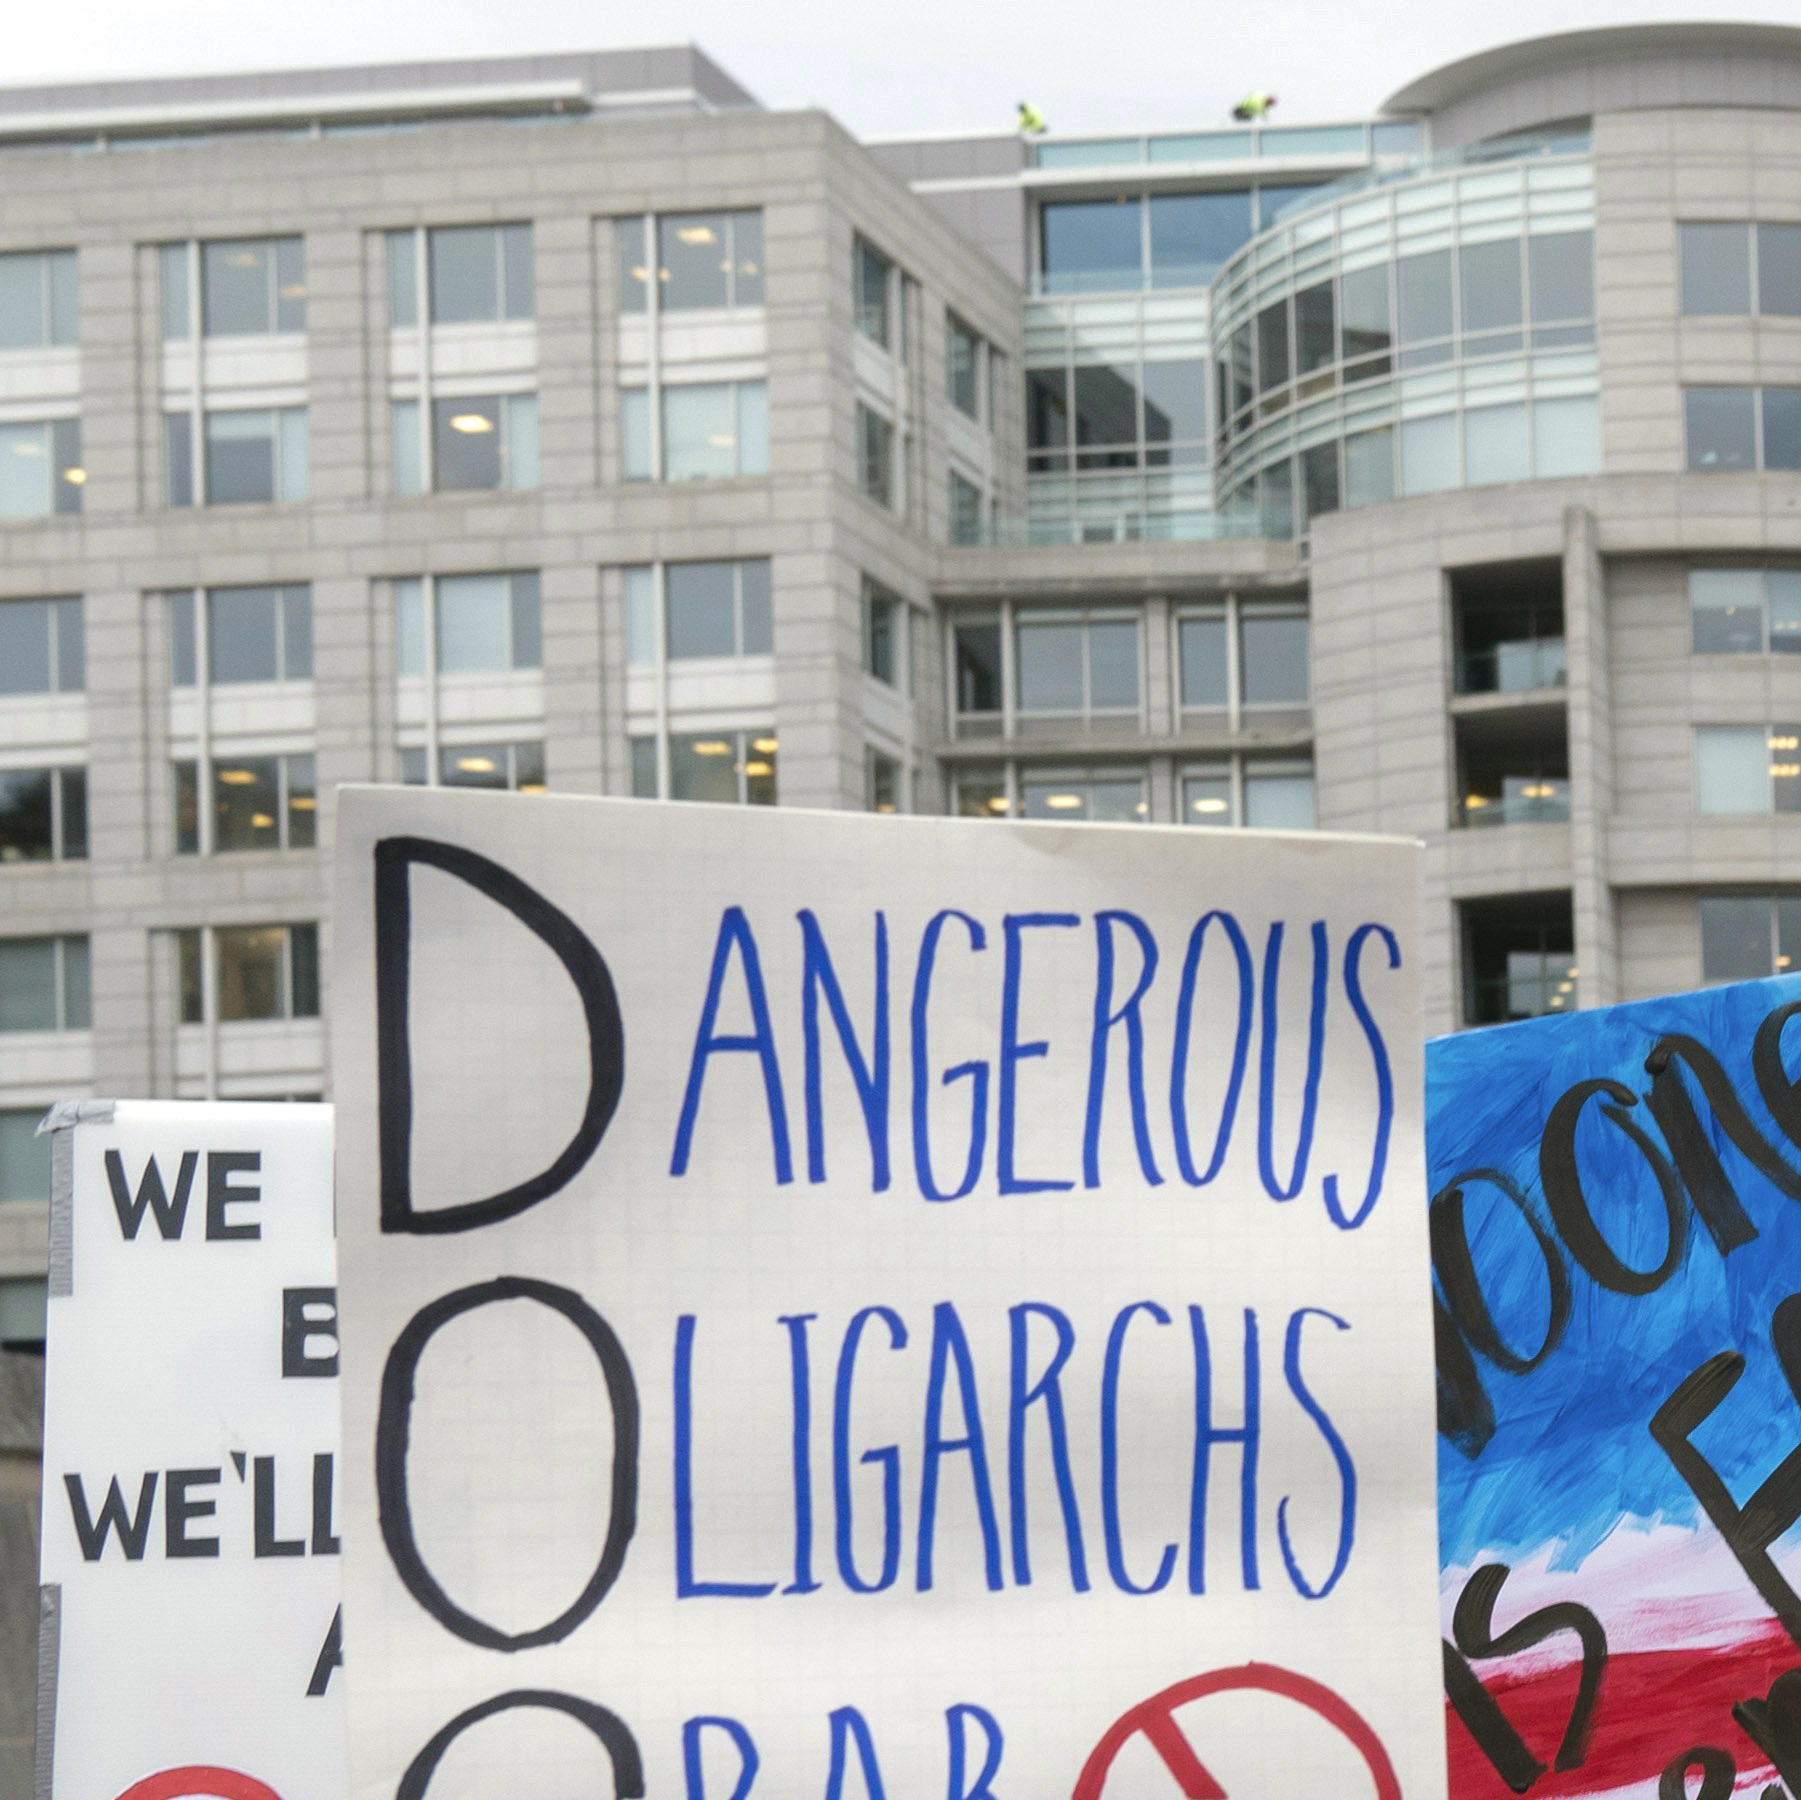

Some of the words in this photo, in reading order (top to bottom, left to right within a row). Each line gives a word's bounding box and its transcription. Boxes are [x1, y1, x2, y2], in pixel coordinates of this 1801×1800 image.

[105, 1150, 261, 1240] WE
[374, 836, 1401, 1235] DANGEROUS
[374, 1275, 1357, 1652] OLIGARCHS
